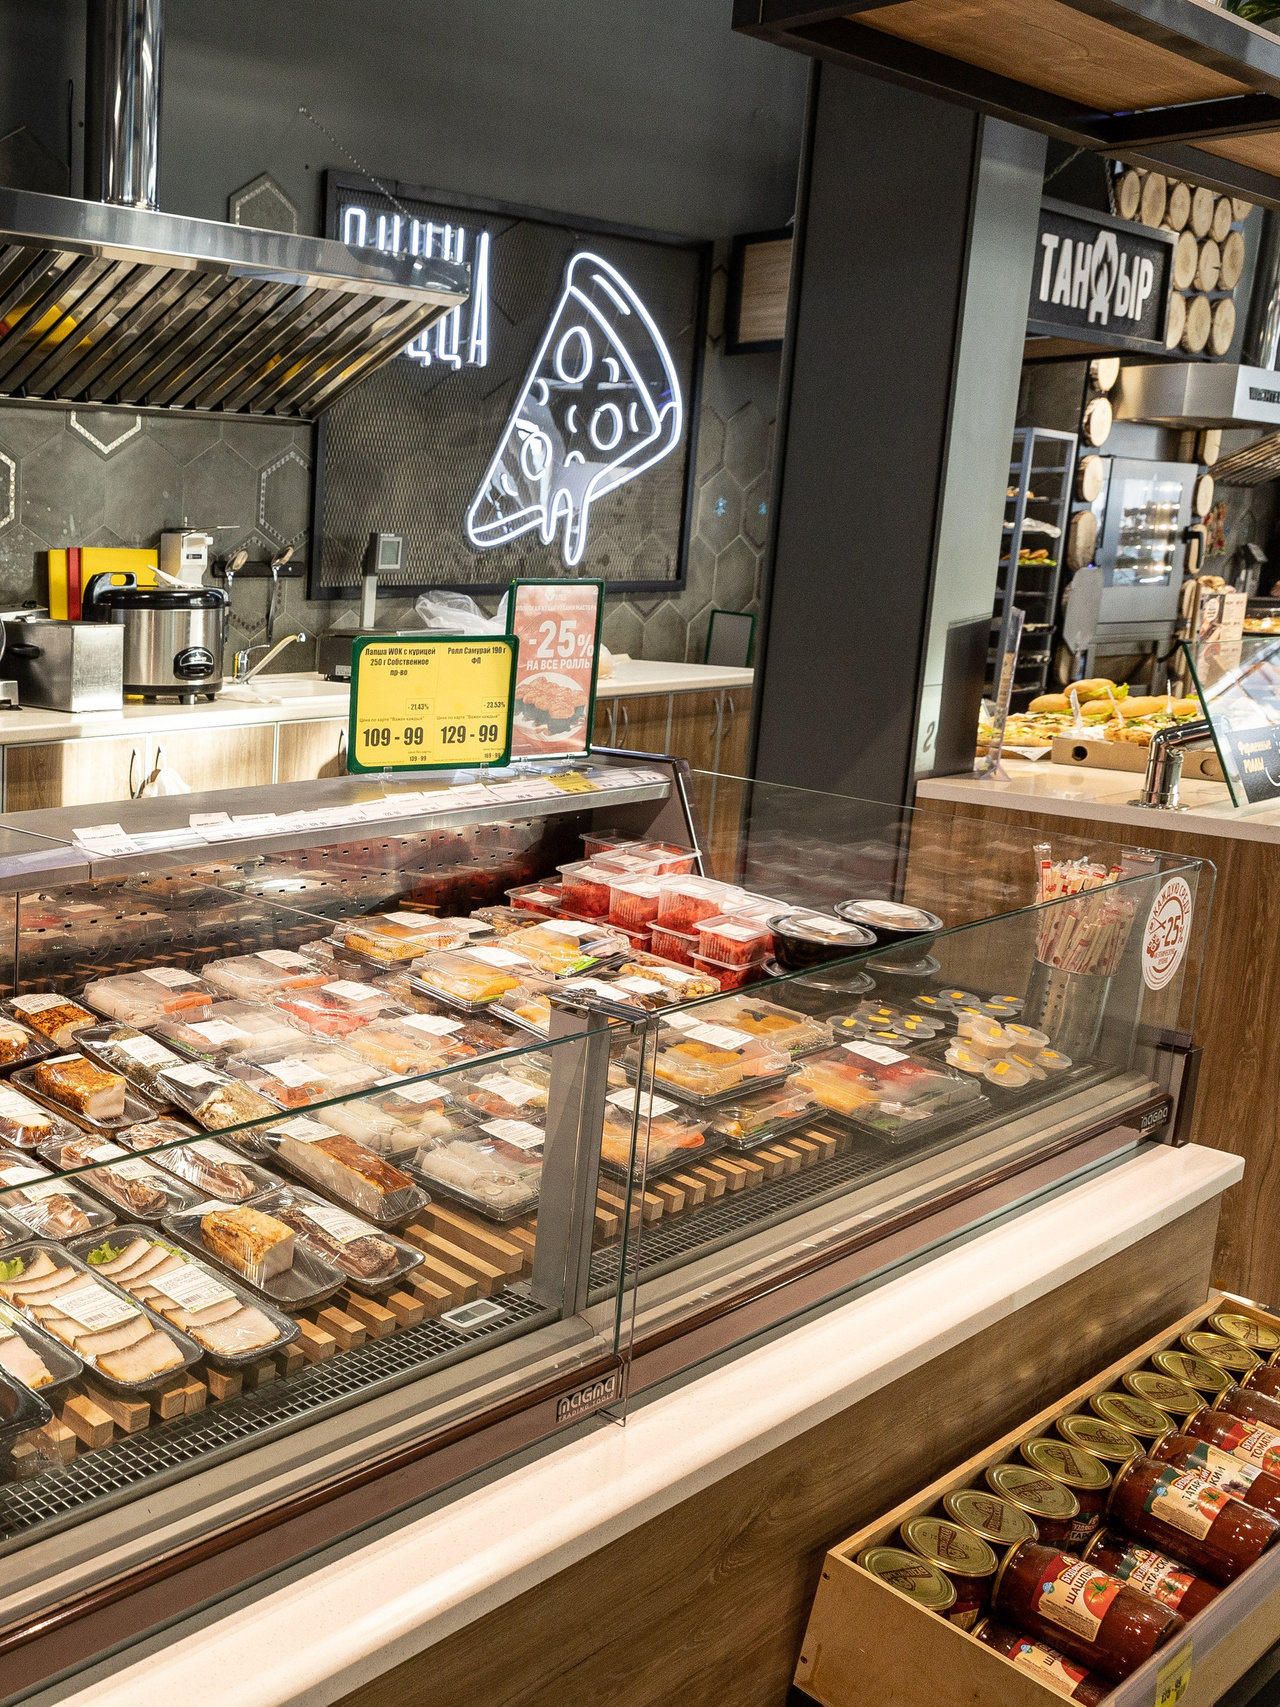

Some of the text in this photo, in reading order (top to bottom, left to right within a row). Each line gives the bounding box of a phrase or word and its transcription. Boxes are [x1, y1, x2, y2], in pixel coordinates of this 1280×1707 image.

[528, 619, 594, 659] -25%
[365, 648, 387, 656] Лапша
[388, 648, 403, 656] WOK
[408, 647, 436, 657] курицей
[447, 647, 464, 655] Ролл
[464, 646, 491, 655] Самурай
[492, 646, 502, 654] 190
[370, 658, 383, 666] 250
[387, 658, 430, 666] Собственное
[526, 660, 539, 671] НА
[540, 659, 558, 670] ВСЕ
[410, 703, 430, 711] 21.43%
[363, 726, 424, 747] 109 99
[440, 724, 499, 744] 129 99
[1153, 882, 1191, 917] КАЖДУЮ СРЕДУ
[1162, 915, 1185, 947] -25%
[558, 1404, 590, 1423] TRADING
